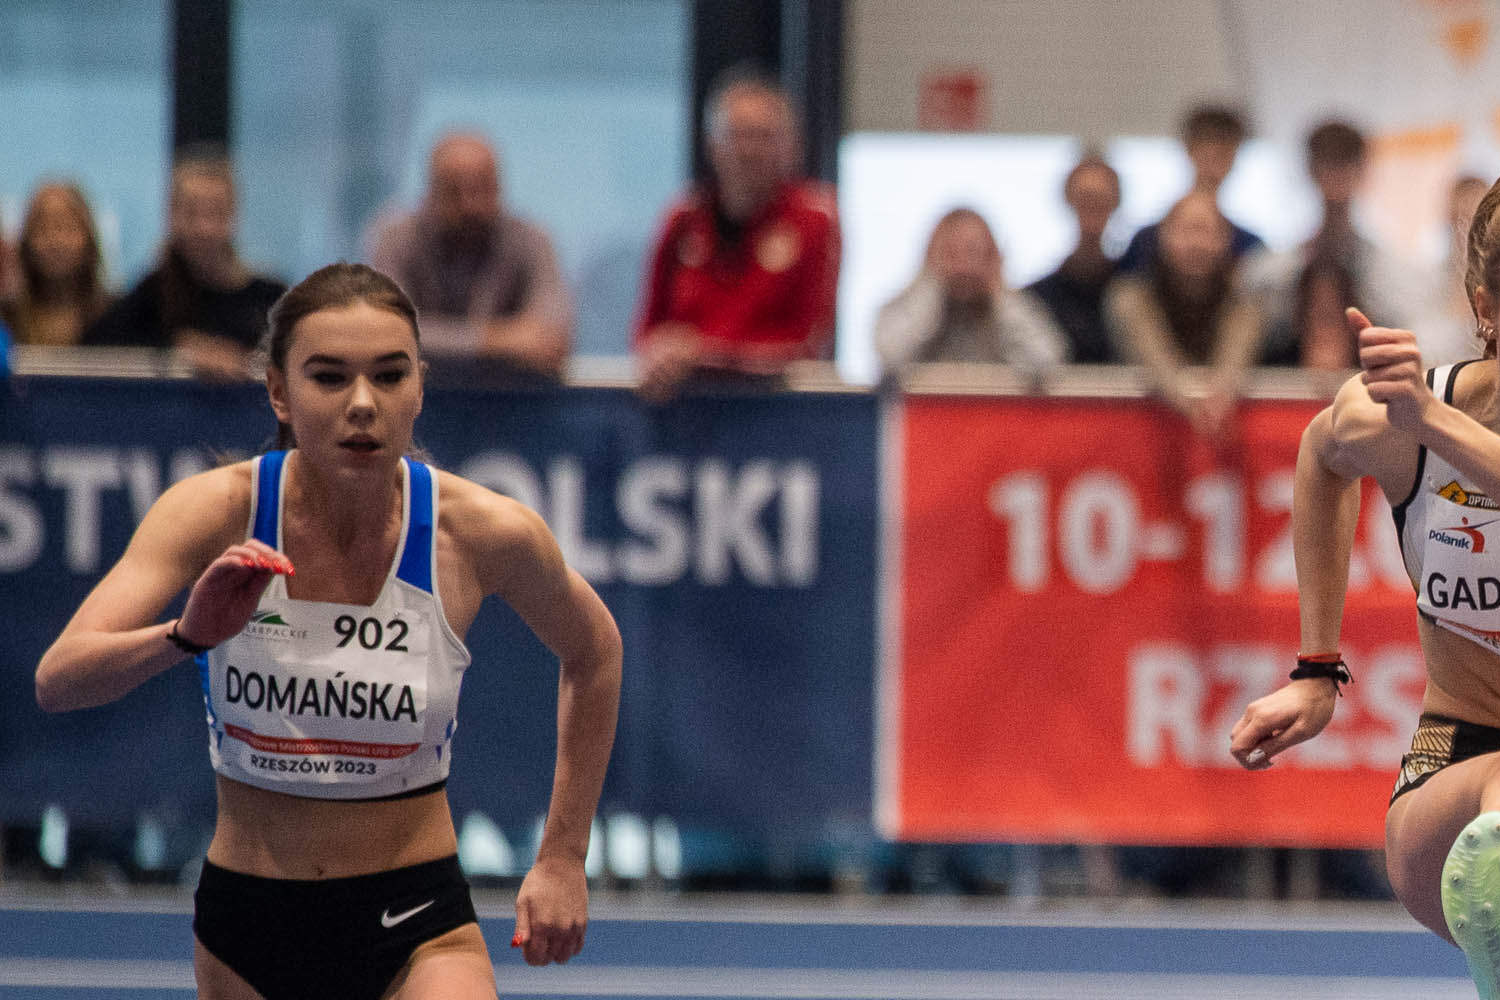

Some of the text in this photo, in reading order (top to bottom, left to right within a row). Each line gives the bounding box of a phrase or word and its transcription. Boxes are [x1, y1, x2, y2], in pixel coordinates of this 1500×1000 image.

[1428, 529, 1470, 549] polanik
[334, 614, 409, 653] 902
[226, 665, 418, 723] DOMAŃSKA
[251, 754, 377, 775] RZESZÓW 2023
